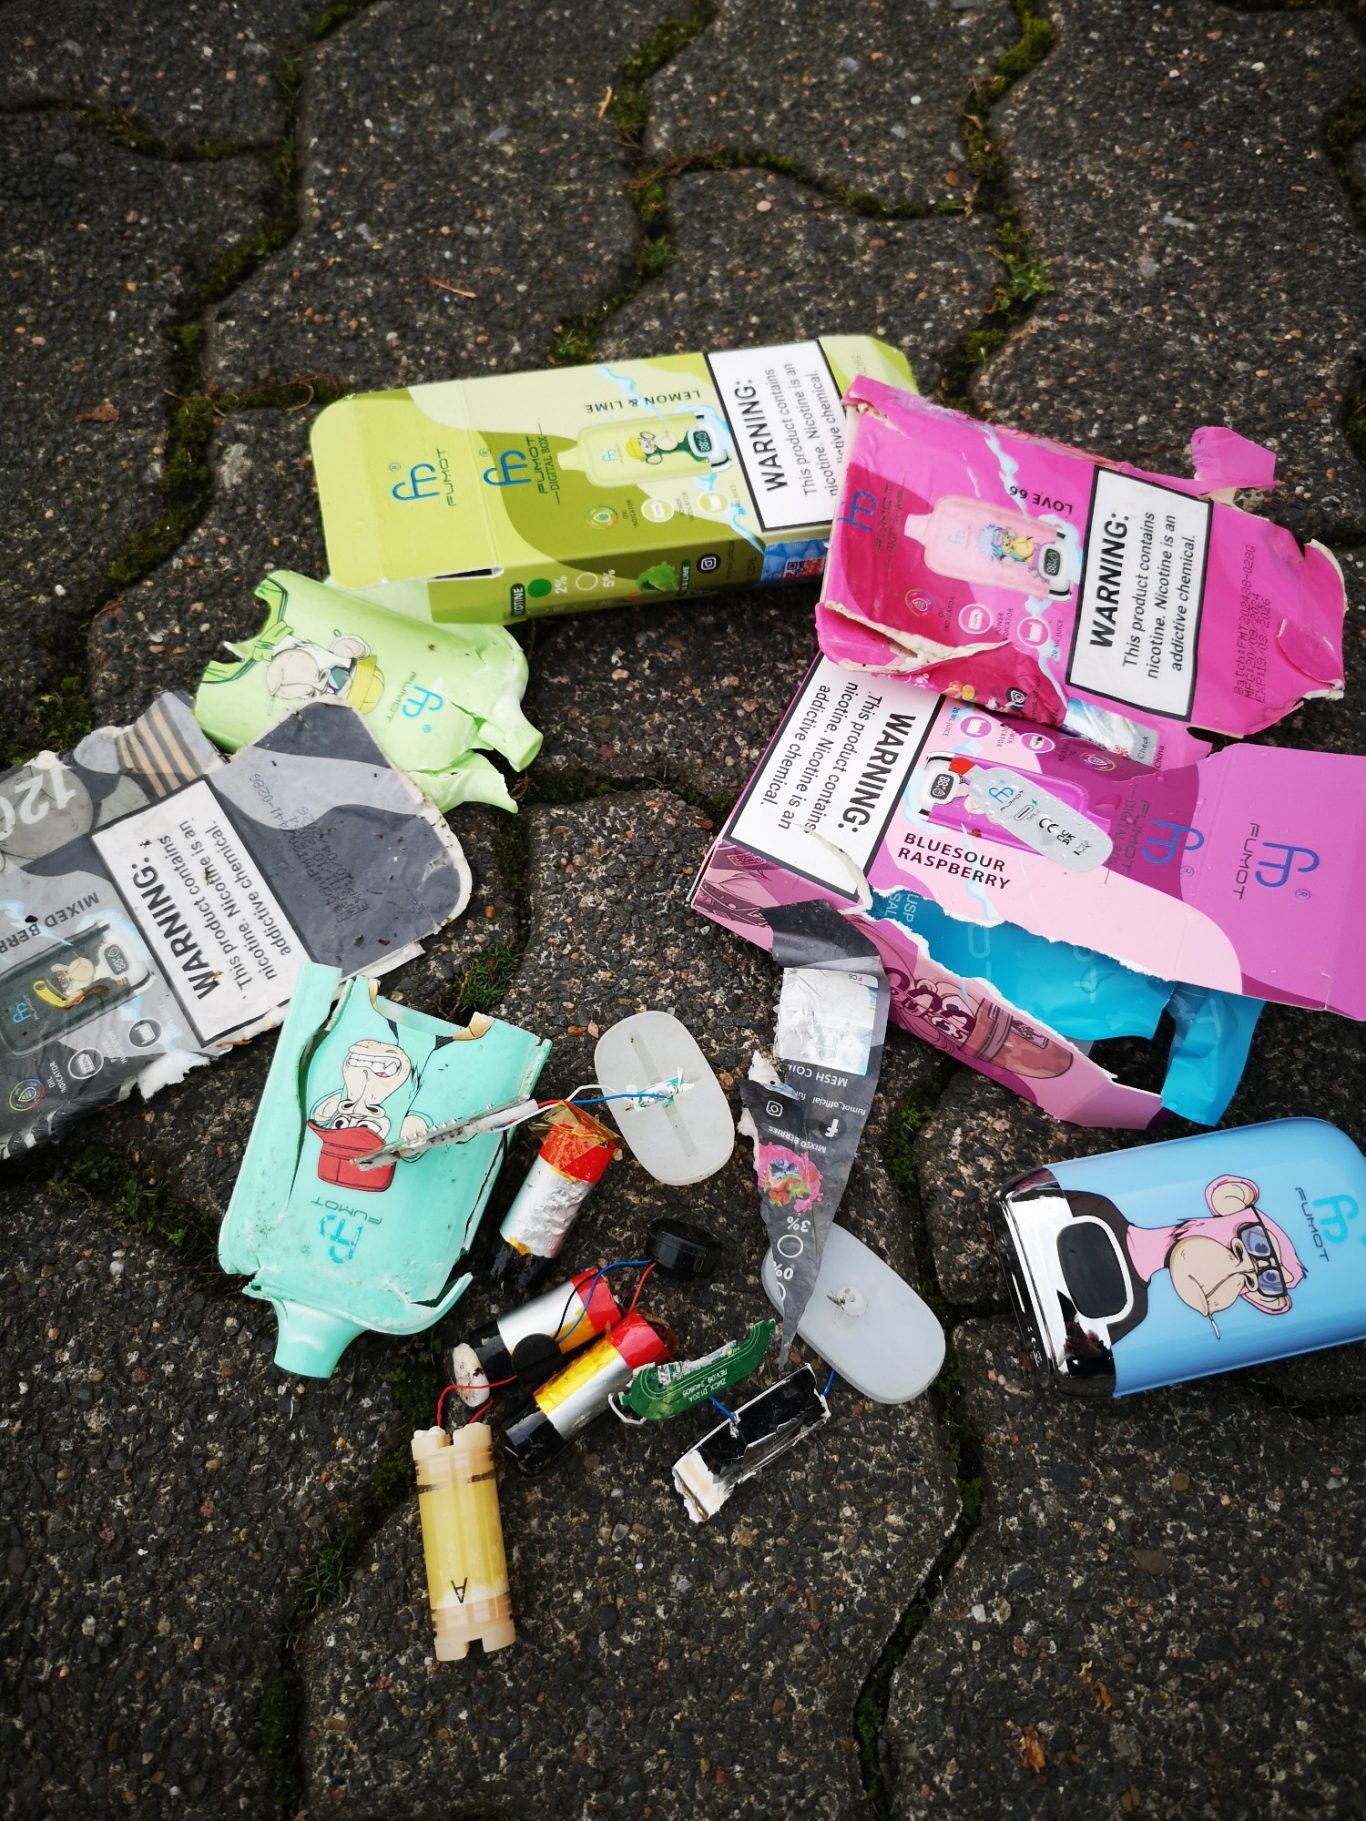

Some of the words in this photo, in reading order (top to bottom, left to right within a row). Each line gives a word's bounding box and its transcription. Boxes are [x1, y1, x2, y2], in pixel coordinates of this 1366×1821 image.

[765, 368, 790, 416] contains
[784, 363, 799, 376] an
[789, 379, 801, 390] is
[585, 400, 623, 414] LIME
[629, 398, 639, 408] &
[644, 390, 700, 405] LEMON
[796, 391, 820, 439] Nicotine
[806, 370, 836, 424] chemical.
[735, 380, 788, 492] WARNING:
[783, 418, 811, 466] product
[436, 448, 456, 506] FUMOT
[526, 436, 548, 494] FUMOT
[544, 455, 560, 492] DIGITAL
[800, 467, 816, 496] This
[815, 443, 838, 496] nicotine.
[1009, 486, 1028, 499] 66
[1032, 493, 1073, 514] LOVE
[1138, 511, 1155, 572] contains
[1160, 535, 1174, 548] is
[1164, 514, 1176, 532] an
[555, 576, 568, 594] 2%
[602, 569, 616, 588] 5%
[1090, 512, 1130, 648] WARNING:
[1154, 550, 1172, 610] Nicotine
[1176, 535, 1196, 602] chemical.
[1132, 574, 1150, 633] product
[1122, 634, 1141, 668] This
[1147, 615, 1166, 680] nicotine.
[1168, 604, 1188, 672] addictive
[794, 684, 832, 742] addictive
[824, 682, 858, 734] nicotine.
[858, 696, 883, 721] This
[796, 737, 835, 793] Nicotine
[834, 720, 866, 773] product
[1136, 736, 1150, 760] Check
[1154, 745, 1165, 769] China
[760, 742, 803, 806] chemical.
[838, 713, 916, 833] WARNING:
[778, 810, 796, 830] an
[788, 792, 808, 808] is
[804, 774, 840, 834] contains
[178, 820, 196, 840] an
[190, 841, 205, 858] is
[903, 832, 1006, 873] BLUESOUR
[1122, 800, 1149, 874] FUMOT
[161, 834, 200, 896] contains
[204, 820, 252, 890] chemical.
[898, 847, 1011, 891] RASPBERRY
[1233, 822, 1260, 900] FUMOT
[45, 892, 100, 928] MIXED
[200, 857, 240, 918] Nicotine
[903, 893, 920, 924] USP
[132, 856, 220, 1000] WARNING:
[193, 896, 236, 955] product
[248, 890, 292, 956] addictive
[238, 918, 278, 981] nicotine.
[230, 955, 254, 991] This
[815, 1072, 849, 1088] MESH
[812, 1096, 867, 1116] fumot_official
[800, 1138, 828, 1154] MIXED
[310, 1196, 384, 1224] FUMOT
[786, 1216, 812, 1233] 3%
[1294, 1186, 1330, 1262] FUMOT
[450, 1576, 468, 1604] A
